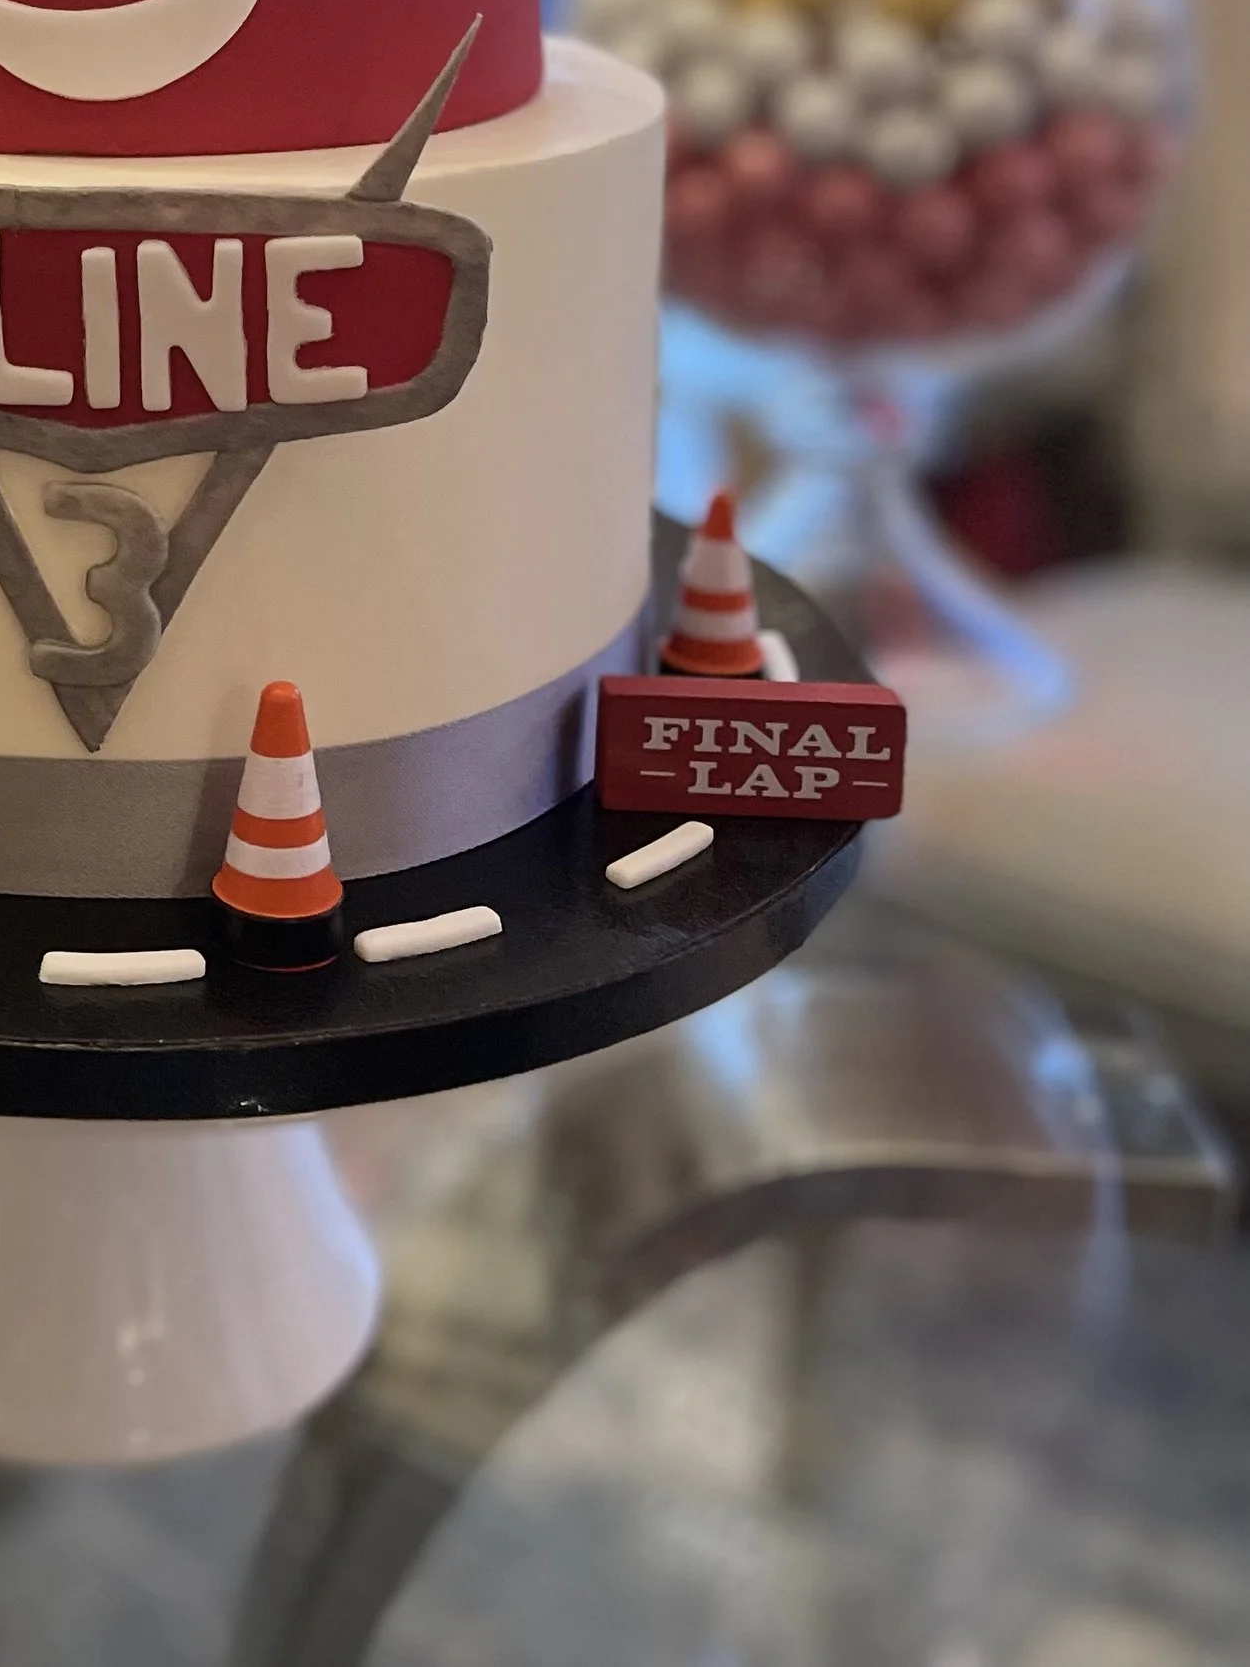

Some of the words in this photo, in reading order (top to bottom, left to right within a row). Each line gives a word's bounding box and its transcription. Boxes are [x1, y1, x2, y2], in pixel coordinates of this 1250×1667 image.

[29, 481, 169, 687] 3
[642, 716, 891, 761] FINAL
[687, 760, 841, 800] LAP
